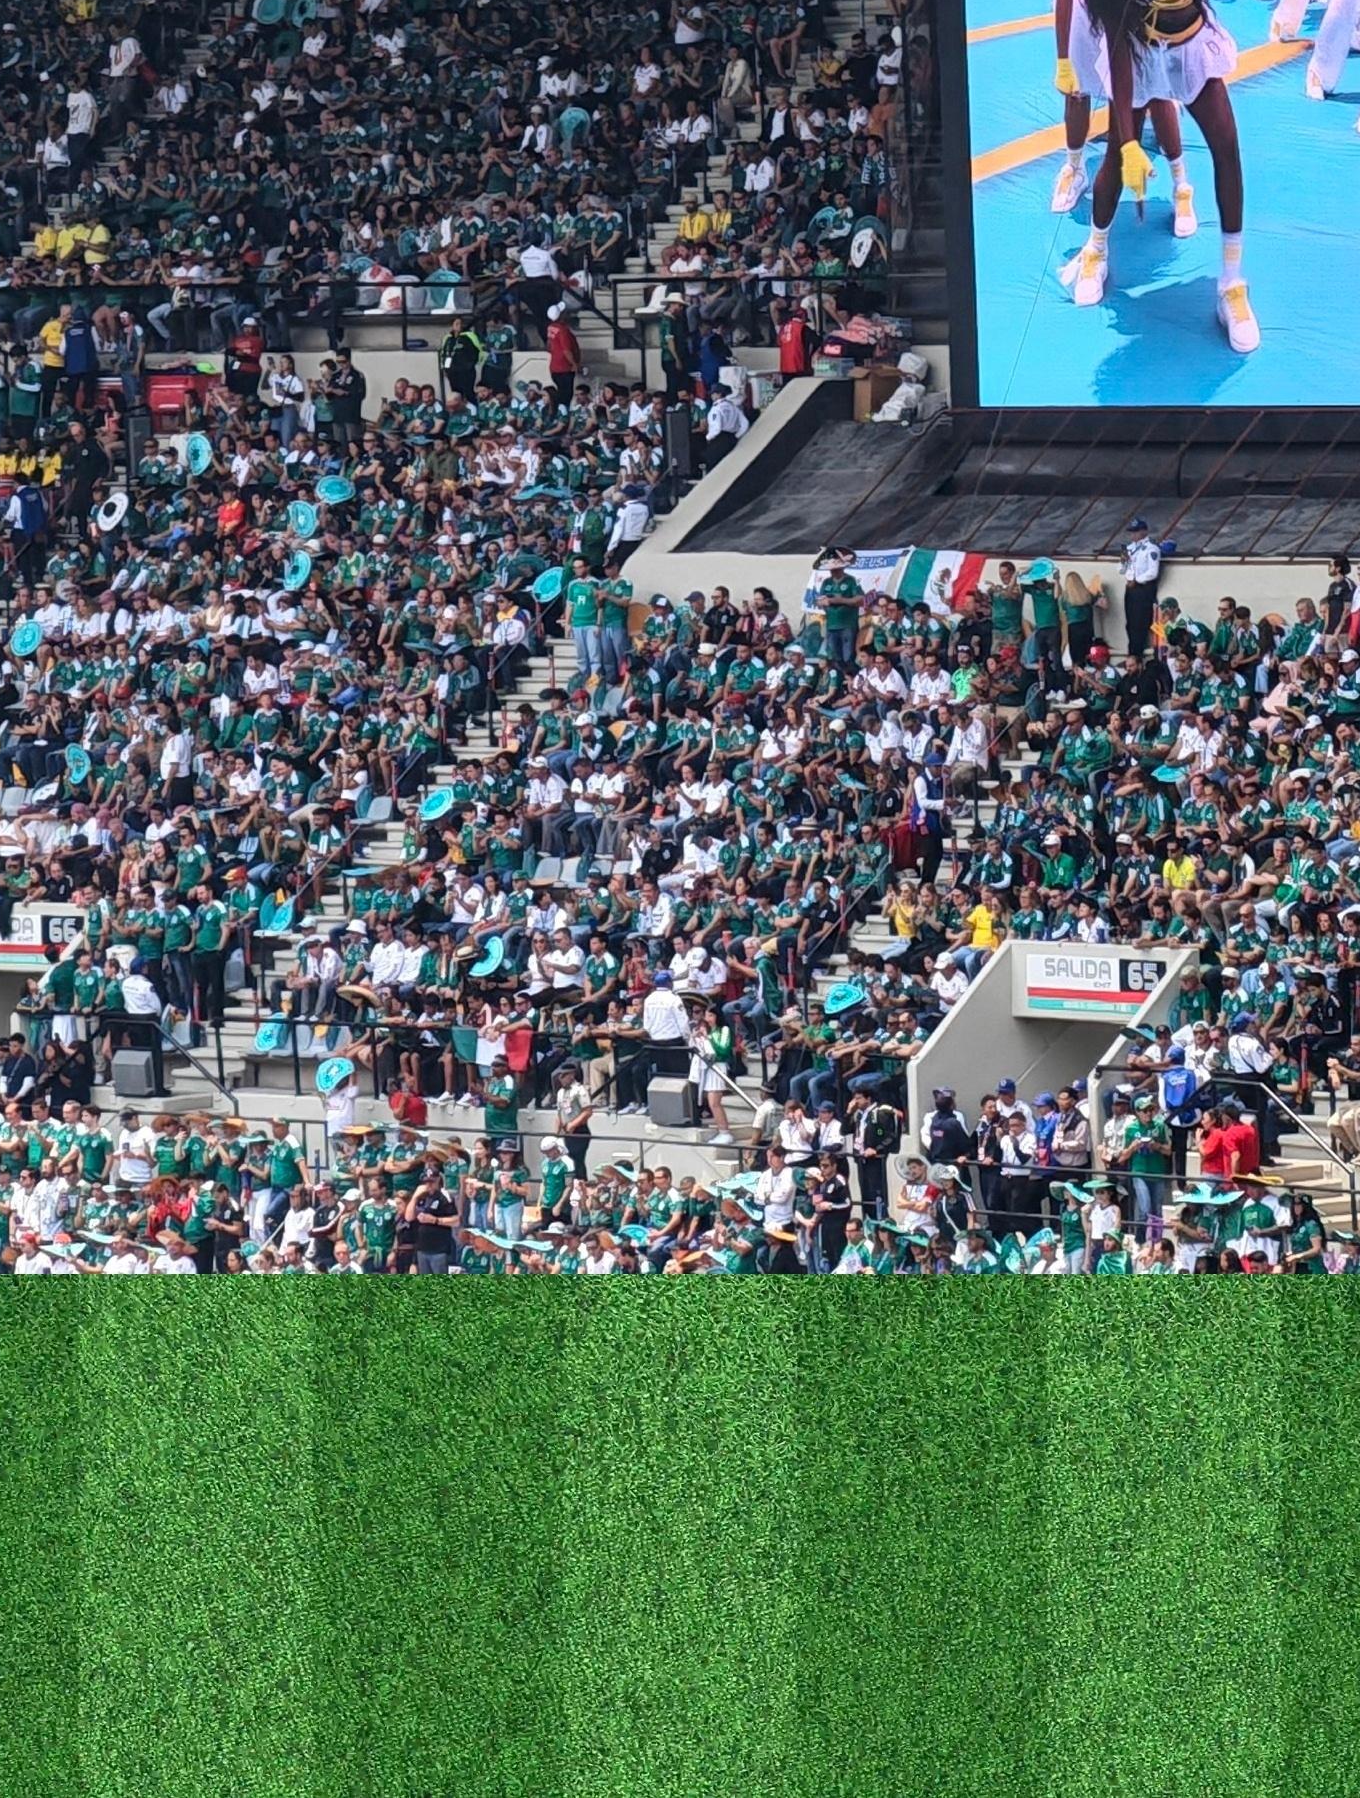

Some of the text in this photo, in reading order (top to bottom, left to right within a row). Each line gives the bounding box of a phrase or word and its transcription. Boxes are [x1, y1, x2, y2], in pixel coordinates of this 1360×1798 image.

[48, 918, 77, 943] 66
[1044, 957, 1159, 991] SALIDA 65
